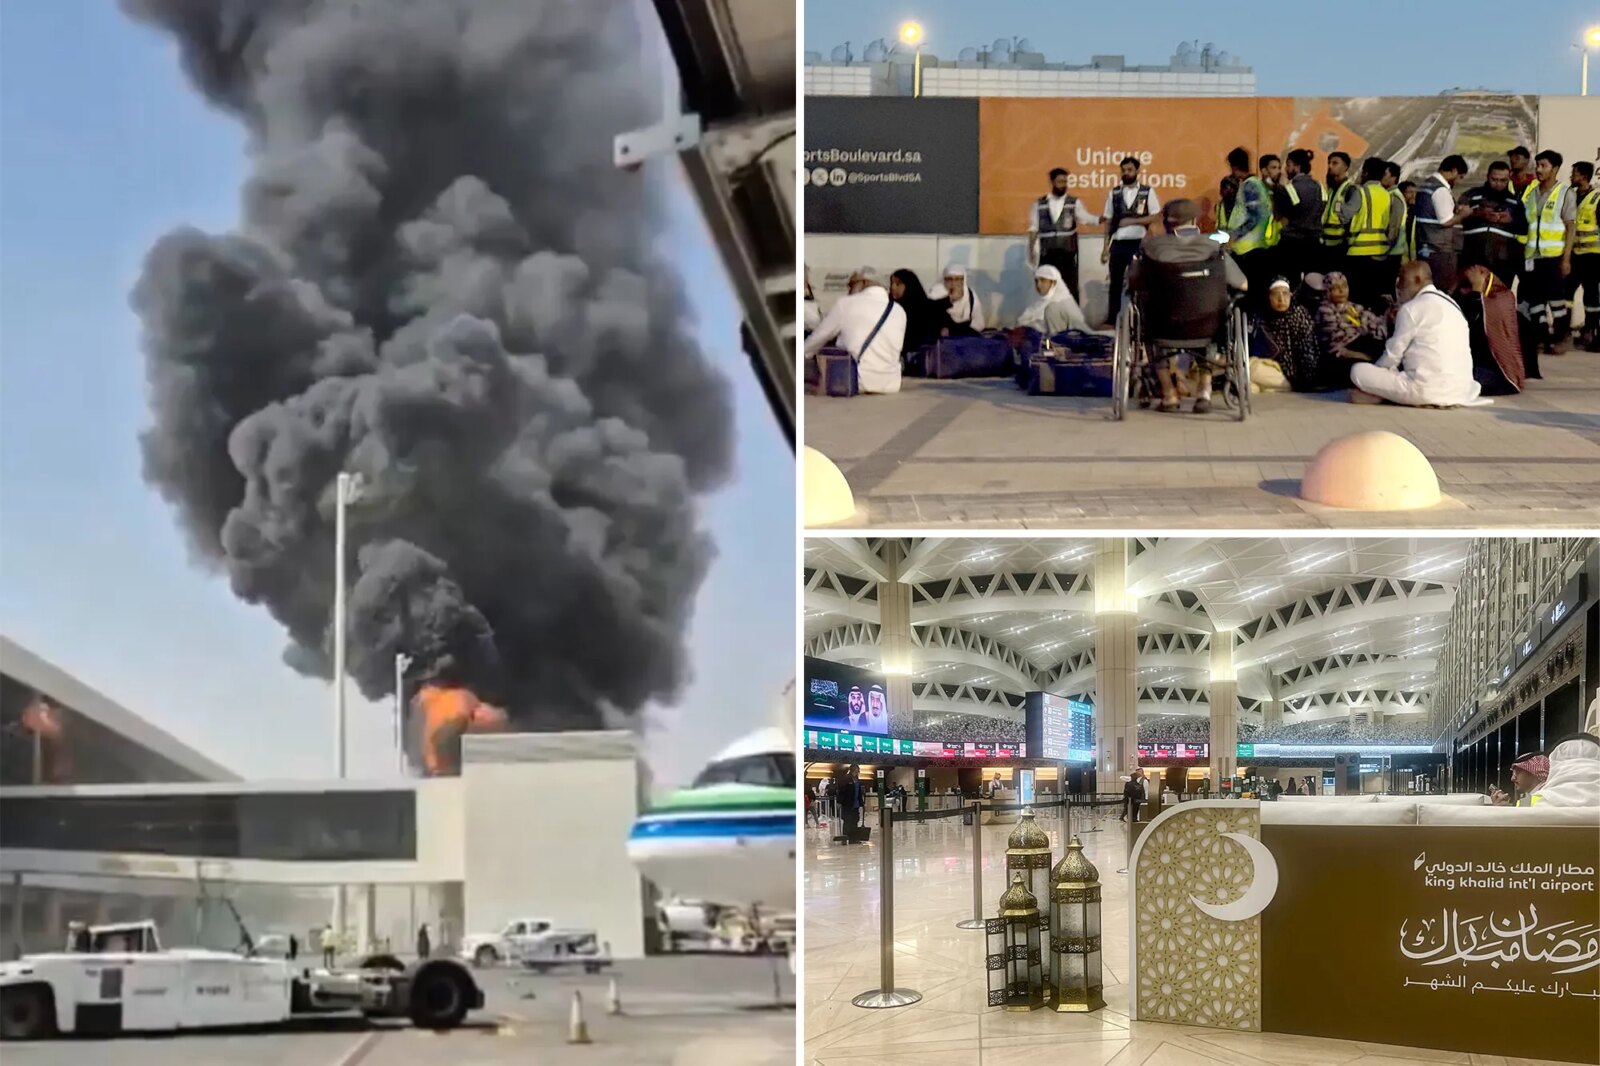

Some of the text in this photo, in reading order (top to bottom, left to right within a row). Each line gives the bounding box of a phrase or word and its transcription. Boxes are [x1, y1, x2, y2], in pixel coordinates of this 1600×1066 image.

[848, 171, 922, 185] @SportsBlvdSA
[1066, 168, 1187, 188] estinions
[1425, 861, 1595, 878] مطار الملك خالد الدولي
[1425, 876, 1595, 893] king khalid int'l airport
[1400, 907, 1521, 969] مبارك
[1403, 973, 1599, 1000] بارك عليكم الشهر
